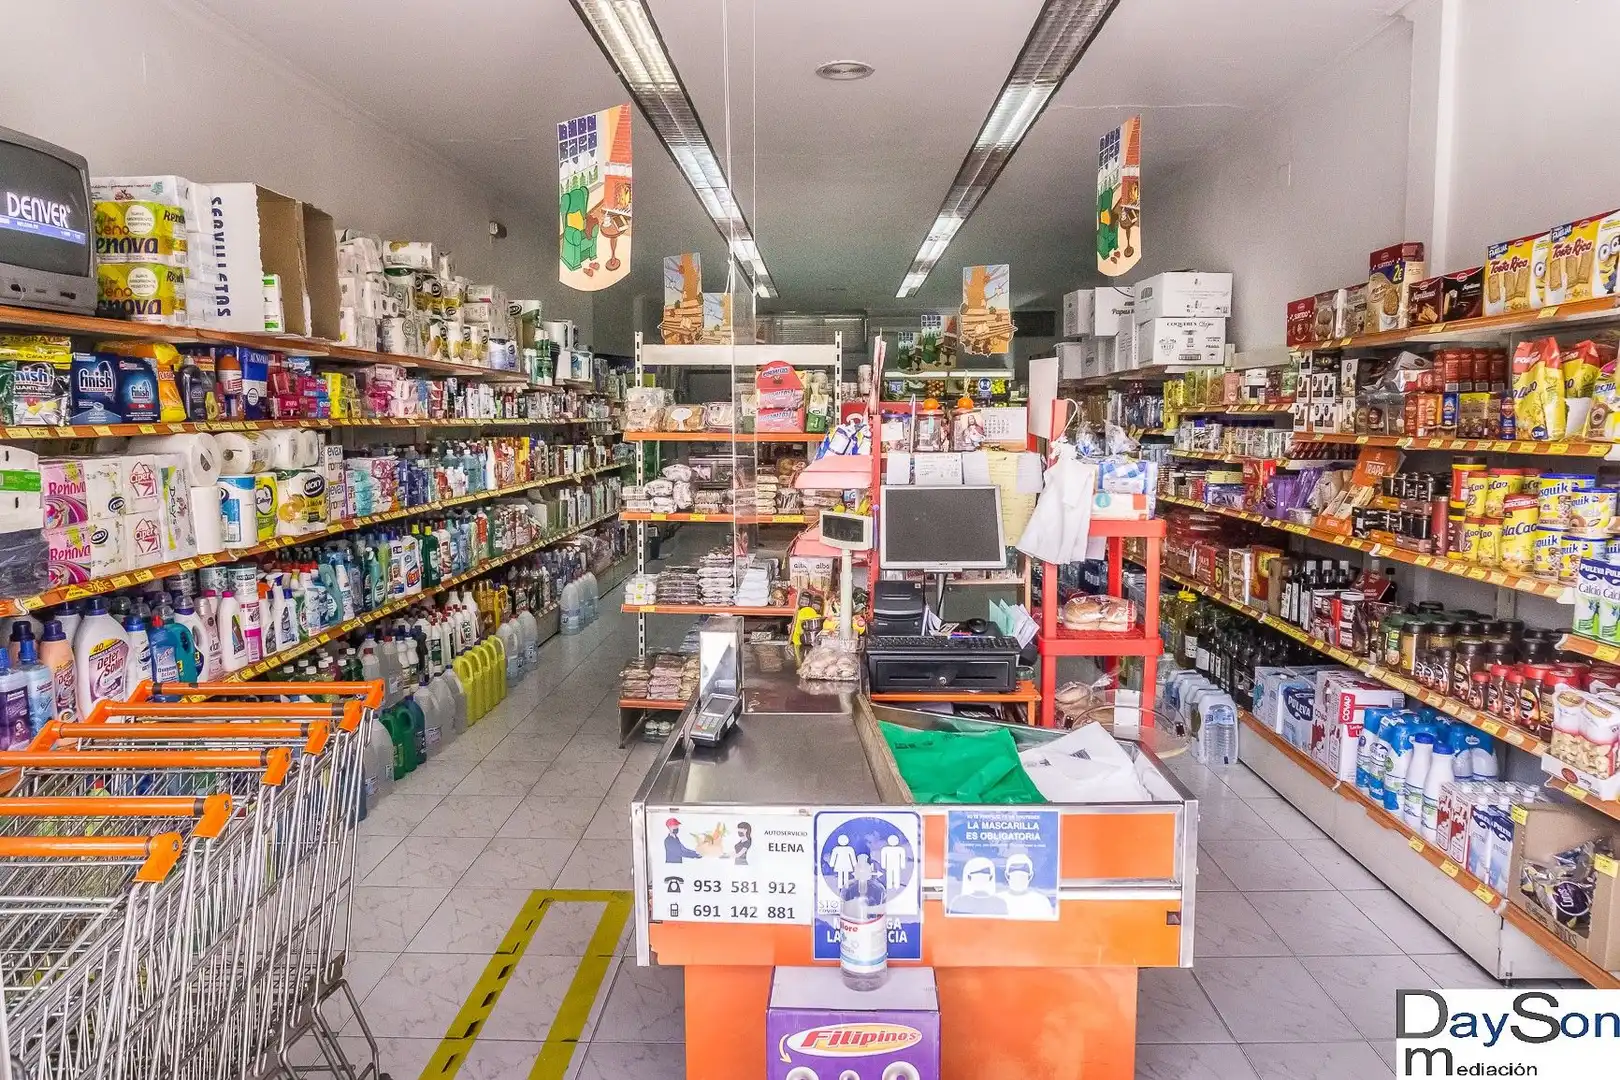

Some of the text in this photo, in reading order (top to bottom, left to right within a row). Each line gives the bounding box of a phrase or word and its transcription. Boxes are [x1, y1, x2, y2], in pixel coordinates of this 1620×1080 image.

[210, 196, 231, 317] SERVILLETAS
[14, 367, 49, 383] nish
[79, 368, 113, 389] finish
[48, 480, 87, 496] Renova
[50, 544, 91, 561] Renova
[1286, 694, 1312, 718] PULEVA
[1341, 695, 1352, 721] COVAP
[763, 829, 808, 837] AUTOSERVICIO
[967, 822, 1040, 830] LA MASCARILLA
[965, 832, 1041, 841] ES OBLIGATORIA
[767, 842, 805, 853] ELENA
[693, 879, 796, 894] 953 581 912
[693, 904, 796, 919] 691 142 881
[801, 1029, 920, 1049] Filipinos
